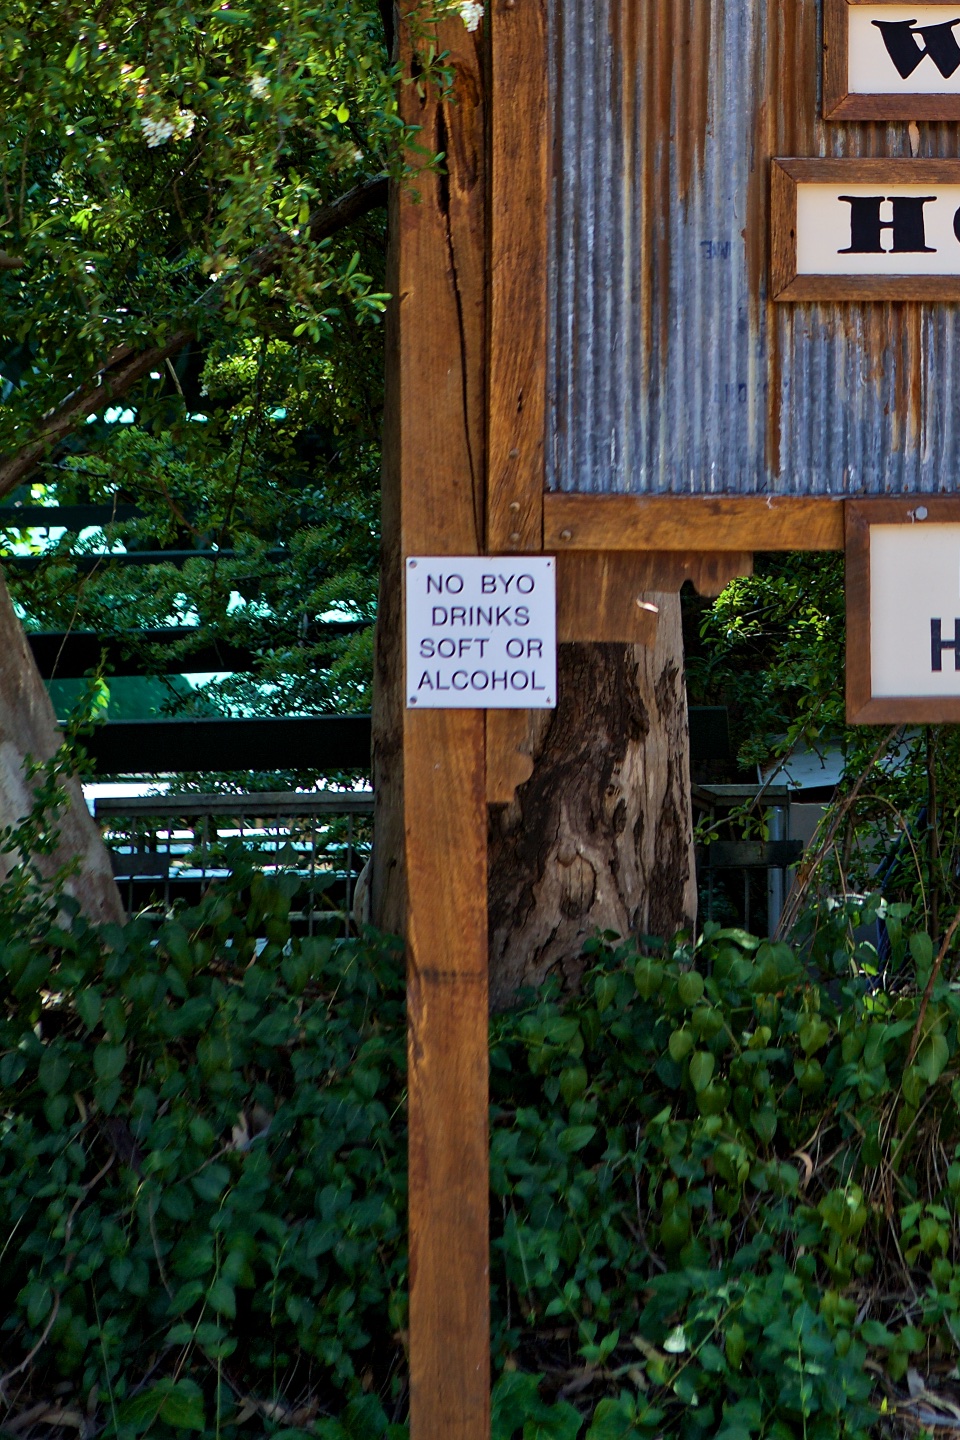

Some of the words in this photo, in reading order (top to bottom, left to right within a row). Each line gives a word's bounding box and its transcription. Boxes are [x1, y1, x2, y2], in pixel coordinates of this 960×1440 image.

[426, 574, 465, 595] NO
[481, 574, 535, 595] BYO
[432, 606, 530, 627] DRINKS
[420, 638, 490, 659] SOFT
[506, 638, 543, 659] OR
[418, 670, 546, 691] ALCOHOL
